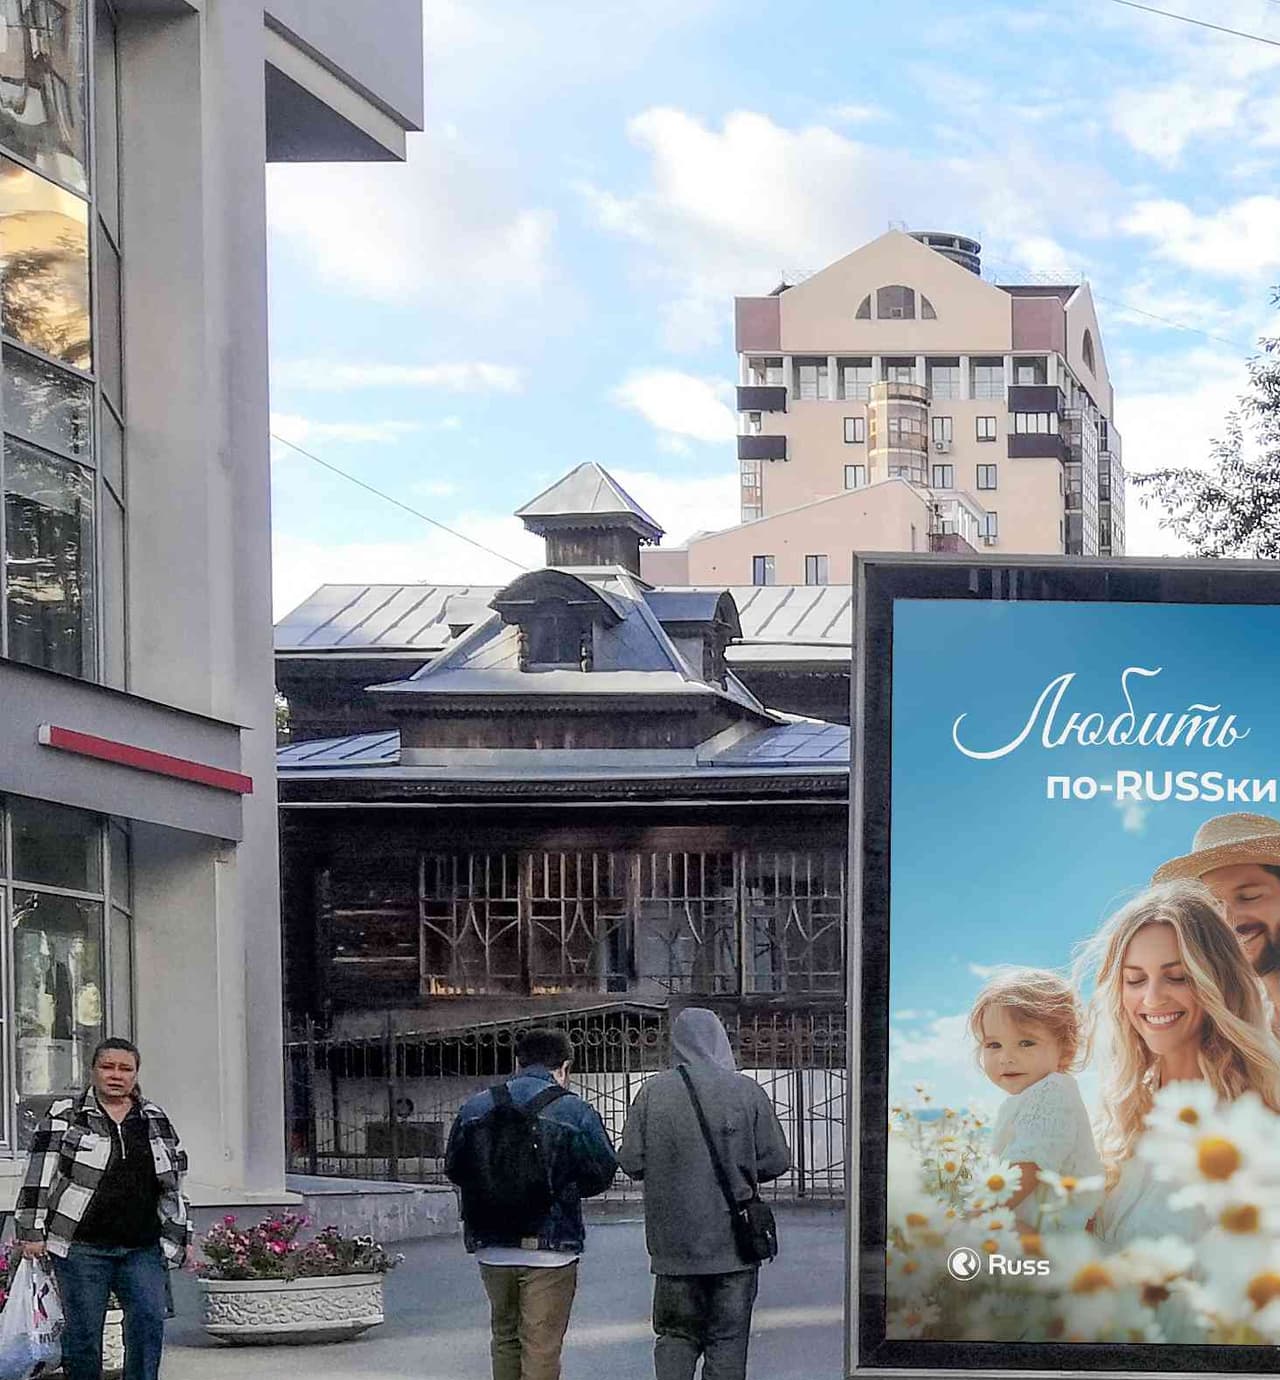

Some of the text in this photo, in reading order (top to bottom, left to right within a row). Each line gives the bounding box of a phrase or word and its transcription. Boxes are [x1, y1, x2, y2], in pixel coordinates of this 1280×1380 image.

[952, 666, 1251, 760] Любить
[1046, 770, 1277, 803] по-RUSSки
[988, 1254, 1051, 1276] Russ
